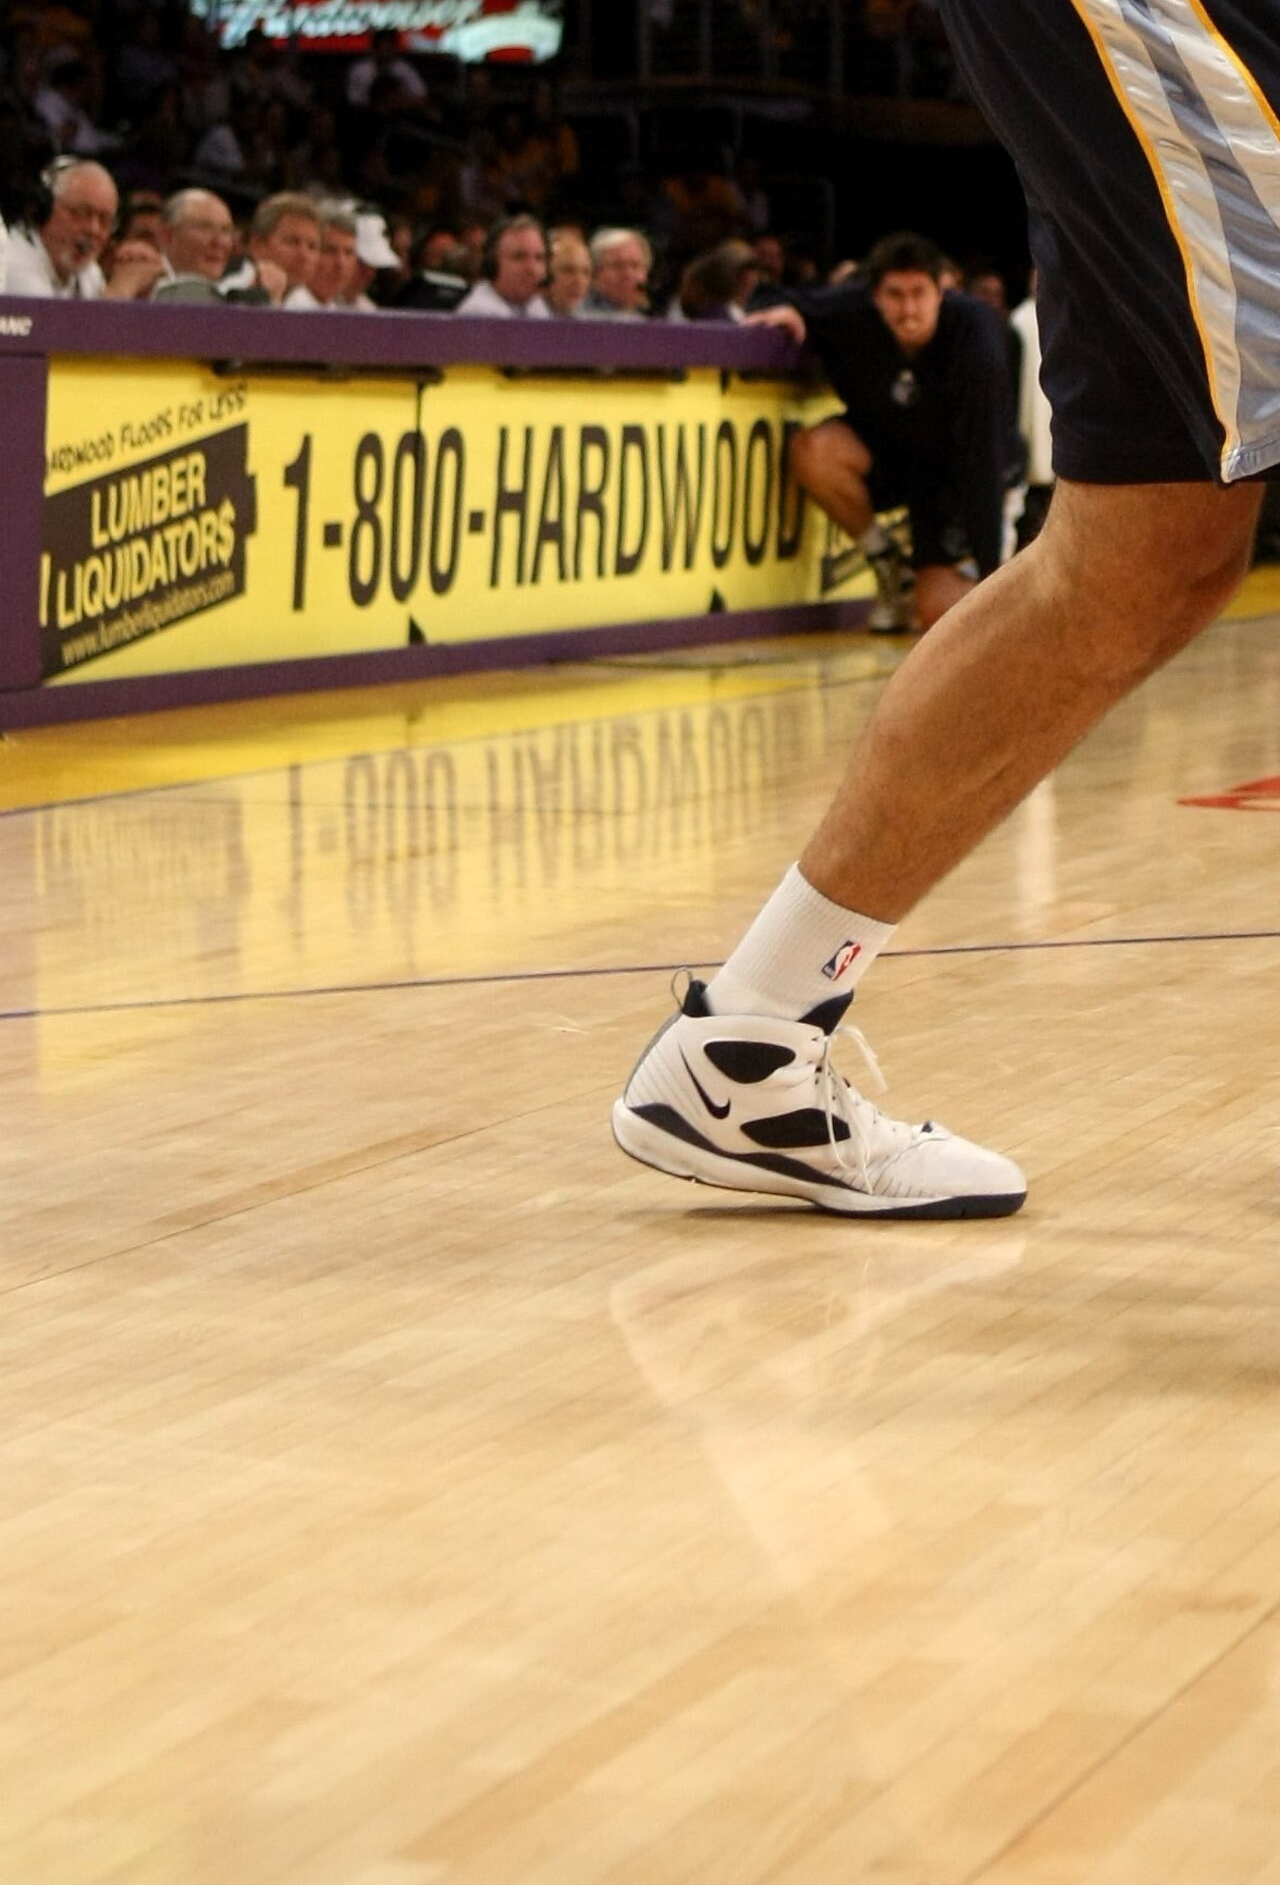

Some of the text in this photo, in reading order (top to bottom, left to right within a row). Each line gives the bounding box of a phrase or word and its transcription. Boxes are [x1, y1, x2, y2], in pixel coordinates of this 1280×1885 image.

[120, 408, 173, 449] FLOORS
[179, 402, 205, 428] FOR
[208, 382, 249, 421] LESS
[91, 450, 206, 549] LUMBER
[283, 418, 804, 612] 1-800-HARDWOOD
